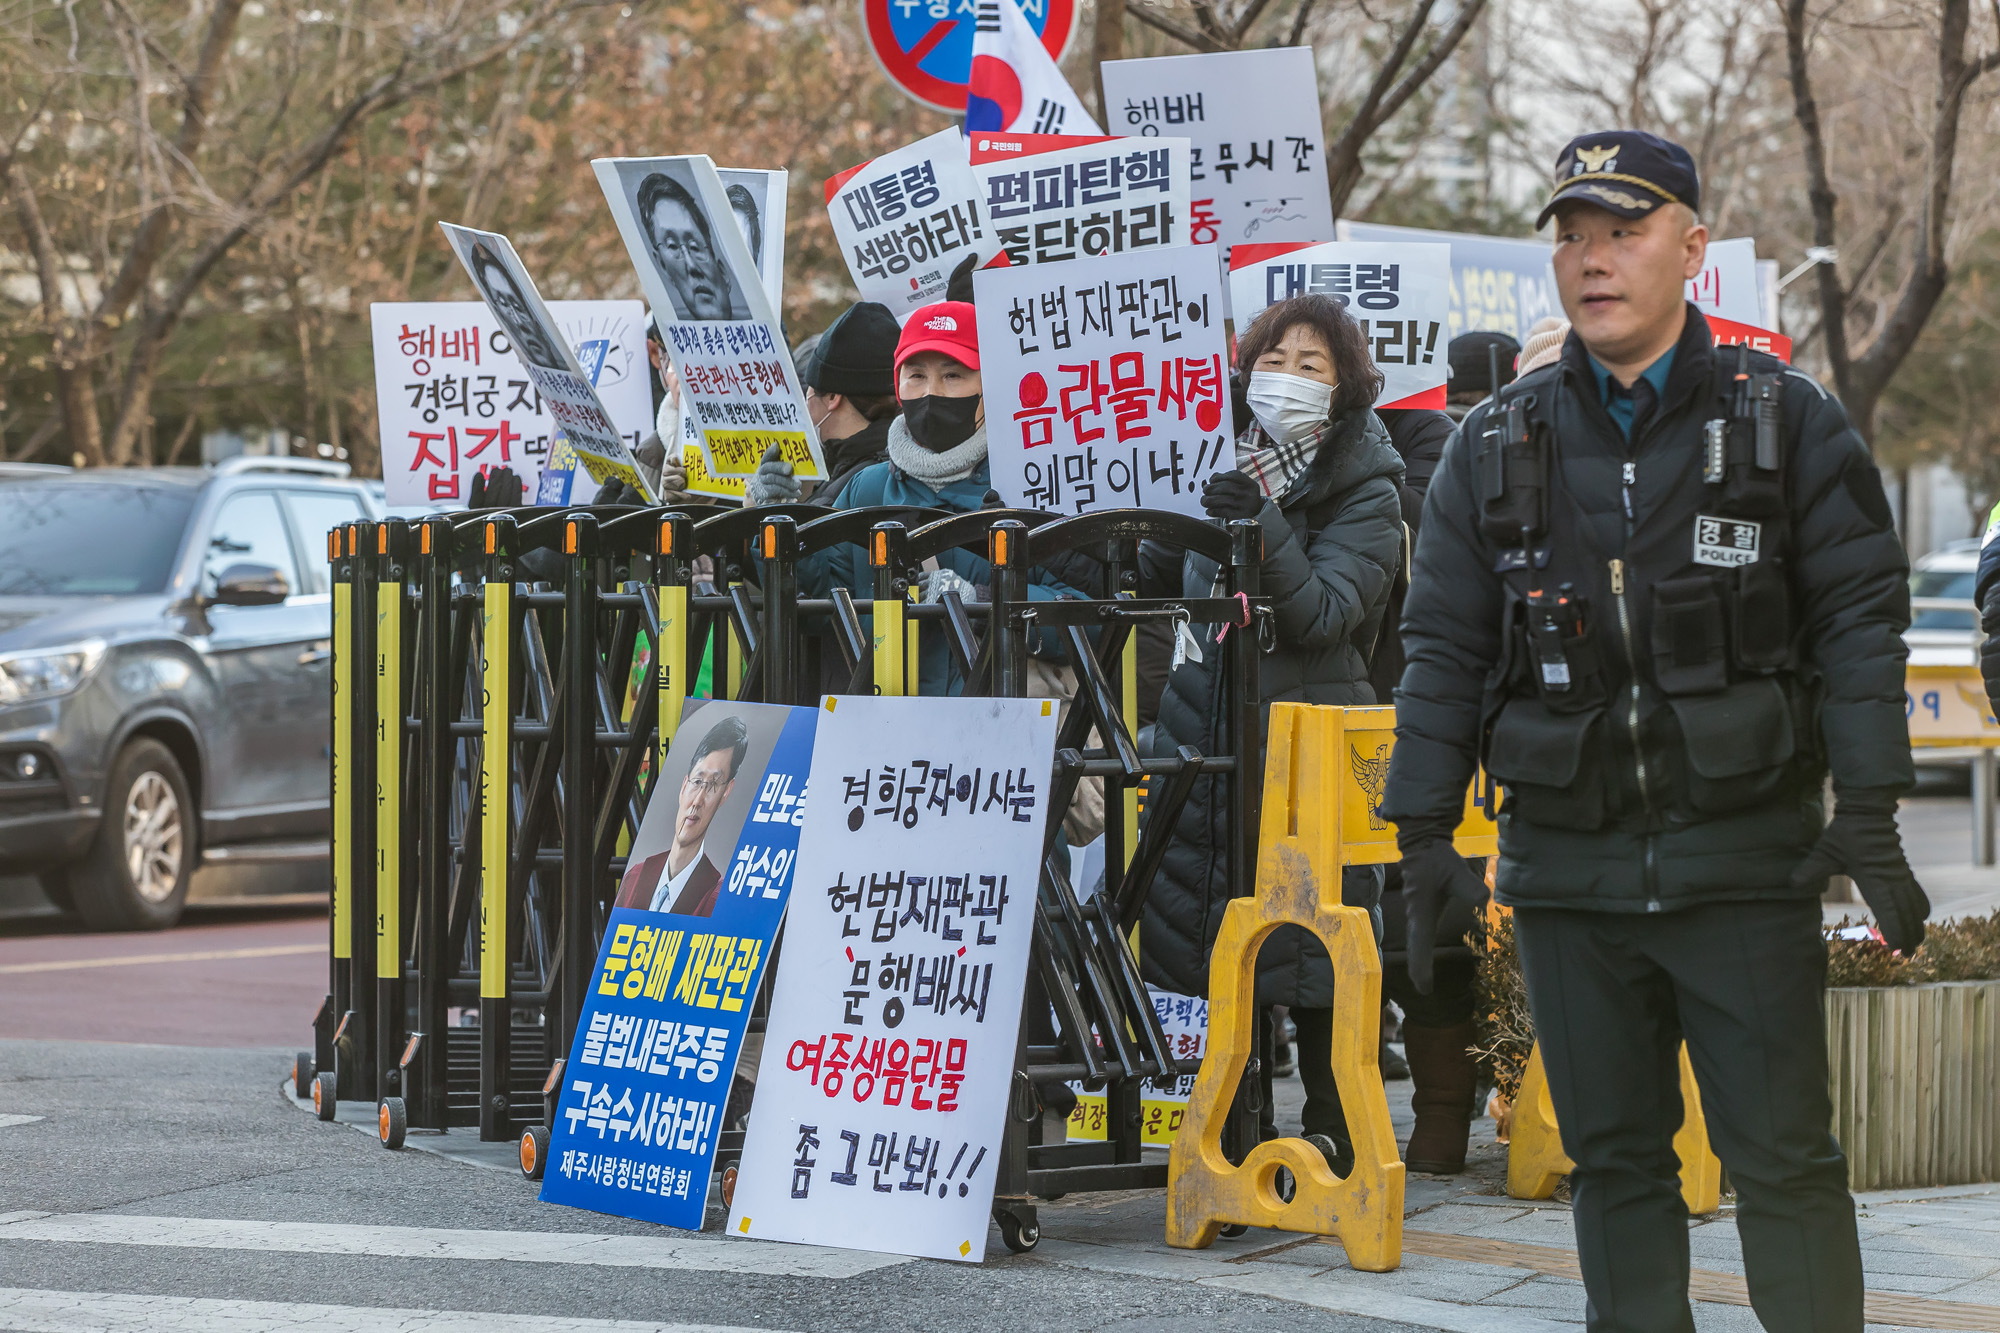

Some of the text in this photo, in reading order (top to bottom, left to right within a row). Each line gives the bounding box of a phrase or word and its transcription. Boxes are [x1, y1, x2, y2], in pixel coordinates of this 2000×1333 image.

[991, 141, 1022, 152] 국민의힘
[1123, 92, 1205, 137] 행배
[842, 159, 940, 232] 대통령
[987, 148, 1170, 219] 편파탄핵
[853, 198, 983, 279] 석방하라!
[996, 201, 1175, 266] 중단하라
[918, 270, 942, 285] 국민의힘
[1266, 263, 1400, 310] 대통령
[702, 324, 726, 356] 졸속
[725, 323, 776, 355] 탄핵심리
[1008, 274, 1208, 356] 헌법재판관이
[685, 360, 790, 396] 음란판사 문형배
[1013, 351, 1223, 450] 음란물시청
[709, 435, 755, 465] 우리법회장
[1701, 549, 1753, 564] POLICE
[727, 845, 796, 900] 하수인
[827, 870, 1010, 947] 헌법재판관
[598, 923, 763, 1013] 문형배 재판관
[580, 1011, 730, 1084] 불법내란주동
[786, 1032, 967, 1113] 여중생음란물
[564, 1080, 716, 1156] 구속수사하라!
[559, 1149, 691, 1200] 제주사랑청년연합회
[791, 1125, 821, 1200] 좀
